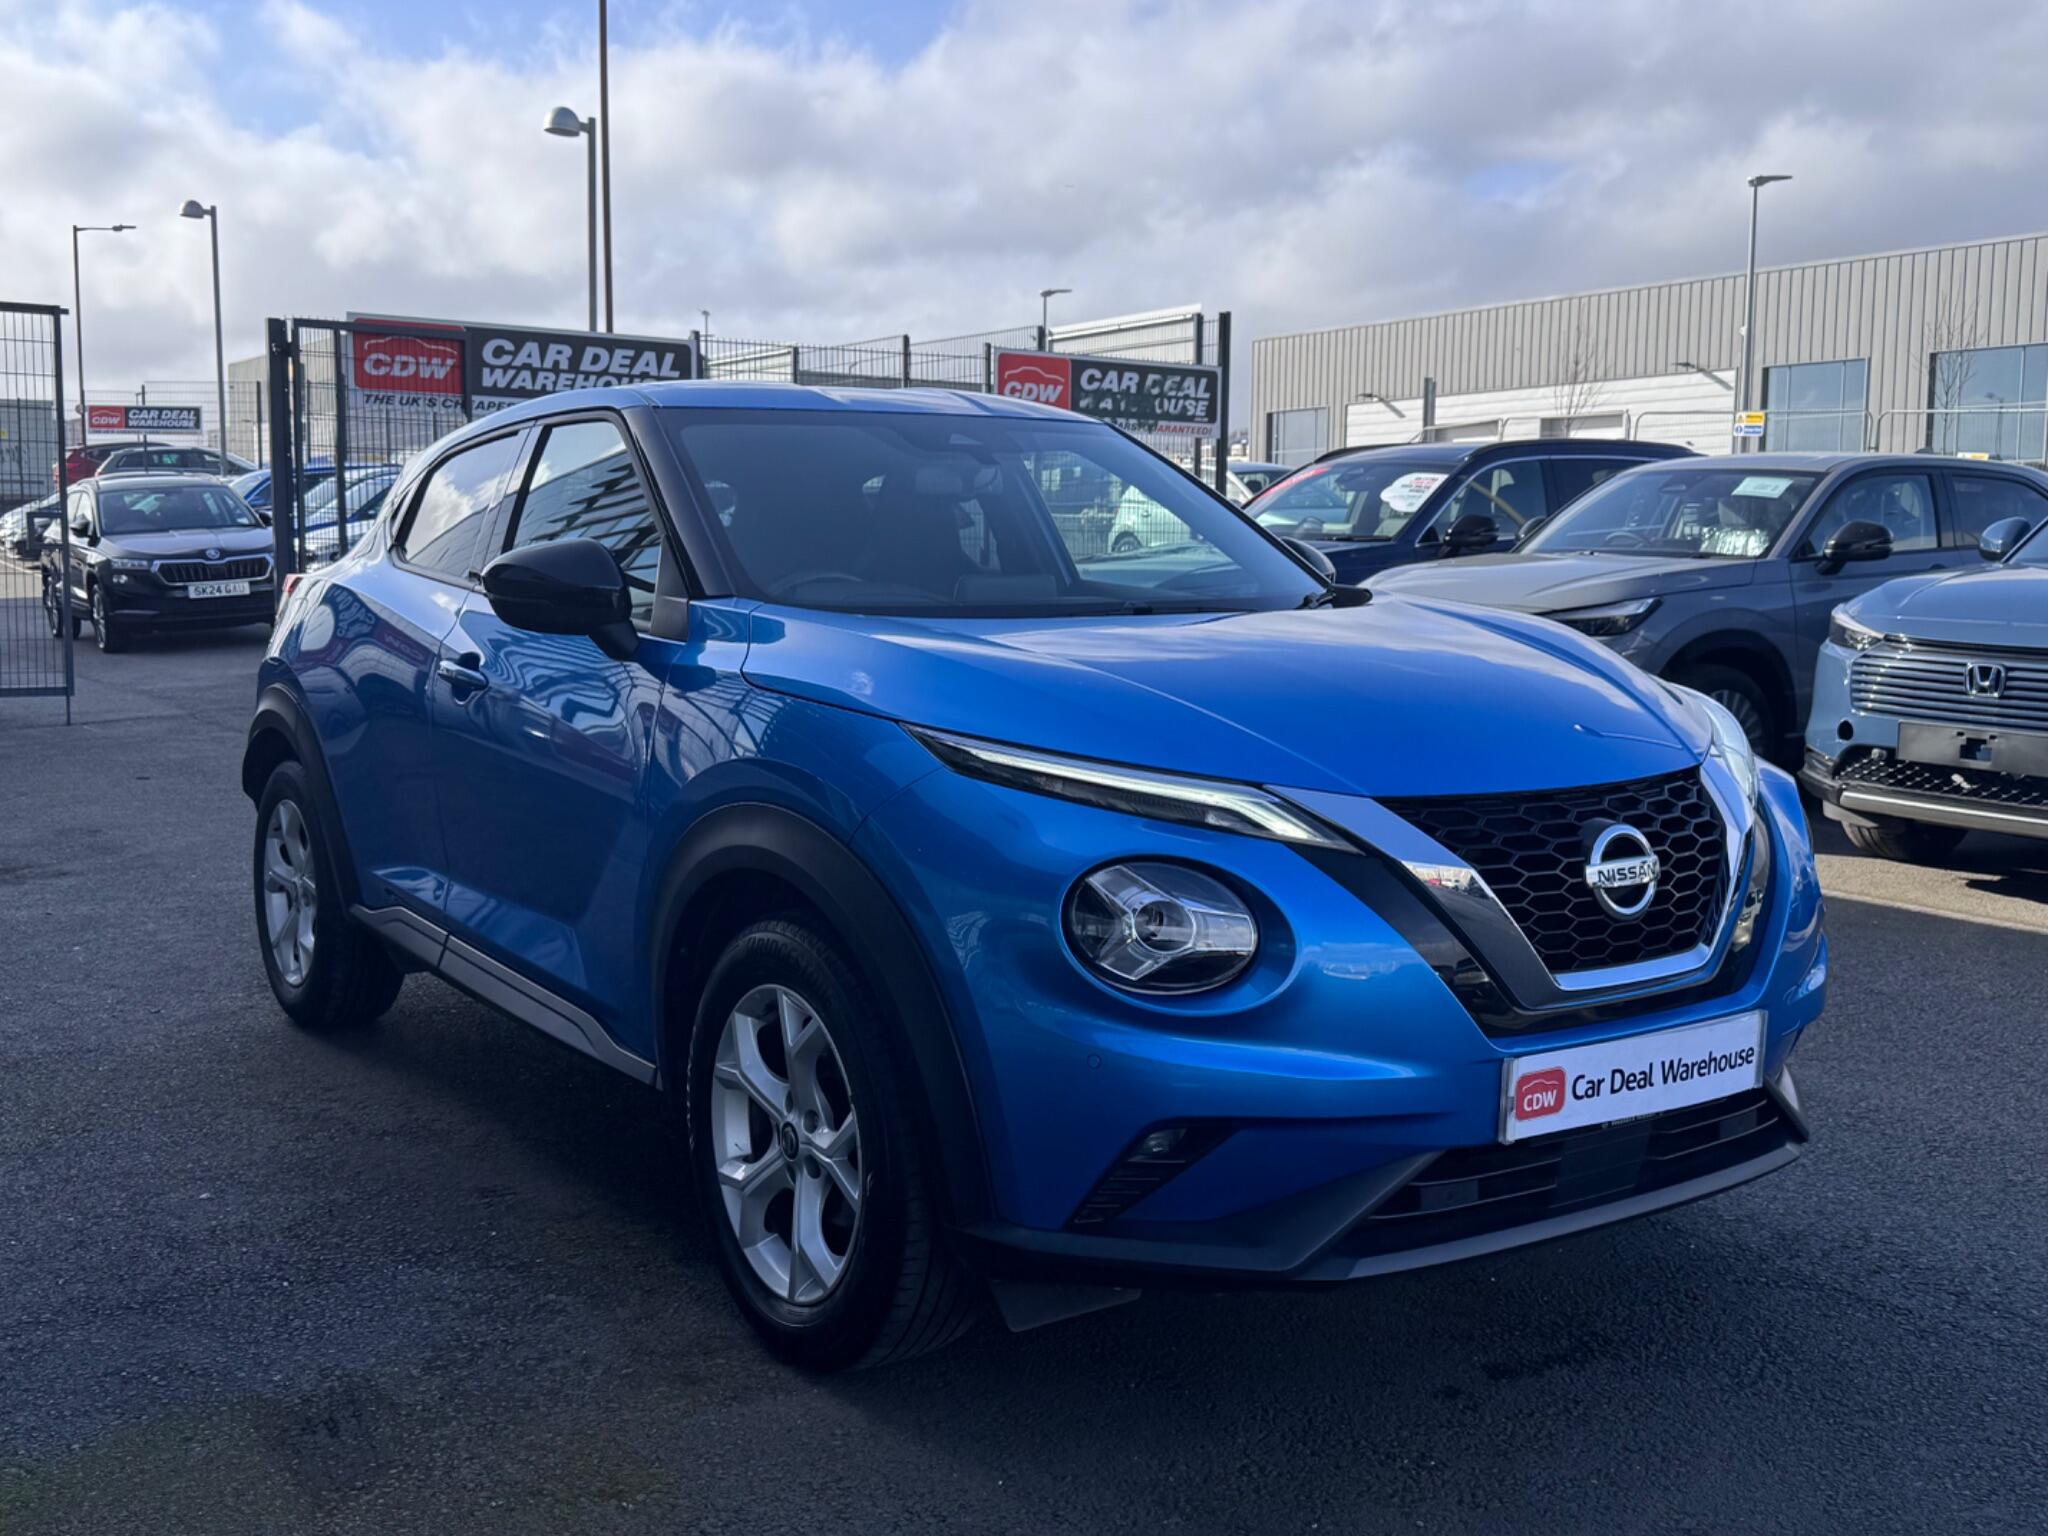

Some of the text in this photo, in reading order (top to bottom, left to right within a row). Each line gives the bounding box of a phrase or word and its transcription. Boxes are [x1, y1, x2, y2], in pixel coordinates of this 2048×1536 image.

[363, 352, 456, 381] CDW
[482, 338, 681, 378] CAR DEAL
[482, 366, 656, 392] WAREHO
[1080, 368, 1211, 398] CAR DEAL
[364, 393, 395, 405] THE
[1004, 381, 1063, 402] CDW
[92, 416, 120, 424] CDW
[129, 409, 196, 419] CAR DEAL
[129, 418, 196, 428] WAREHOUSE
[1597, 860, 1658, 883] NISSAN
[1572, 1046, 1755, 1100] Car Deal Warehouse
[1523, 1090, 1557, 1112] CDW
